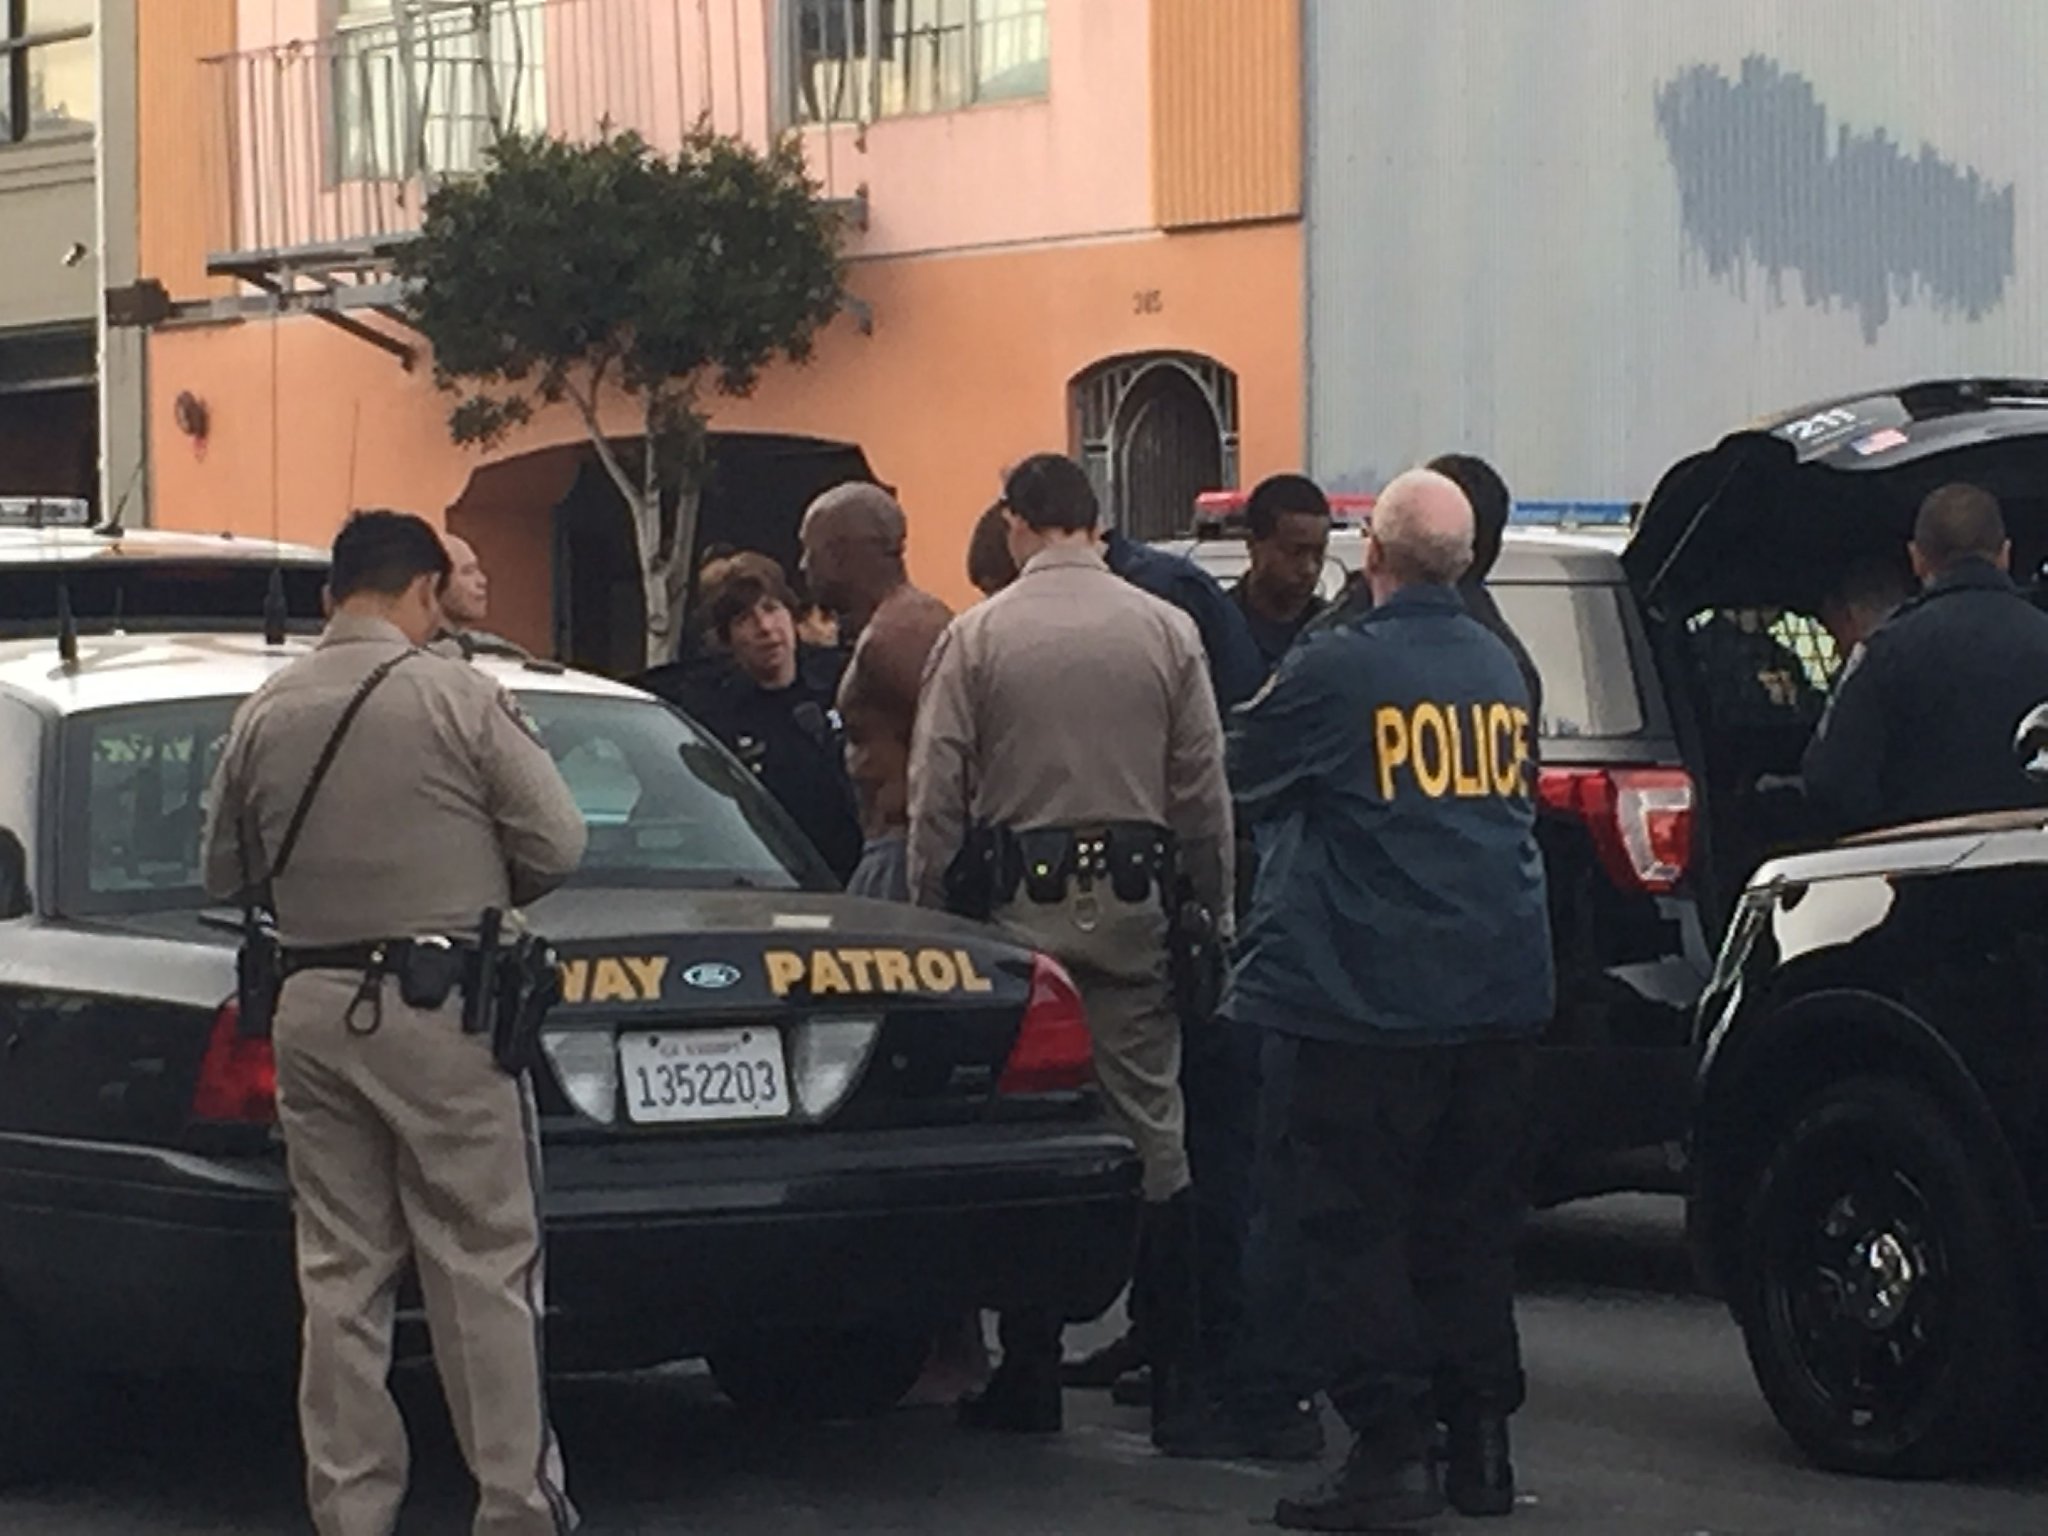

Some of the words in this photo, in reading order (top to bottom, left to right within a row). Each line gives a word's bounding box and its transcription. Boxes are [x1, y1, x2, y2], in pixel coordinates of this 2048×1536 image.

[1375, 700, 1531, 803] POLICE
[763, 948, 993, 997] PATROL
[636, 1060, 777, 1109] 1352203
